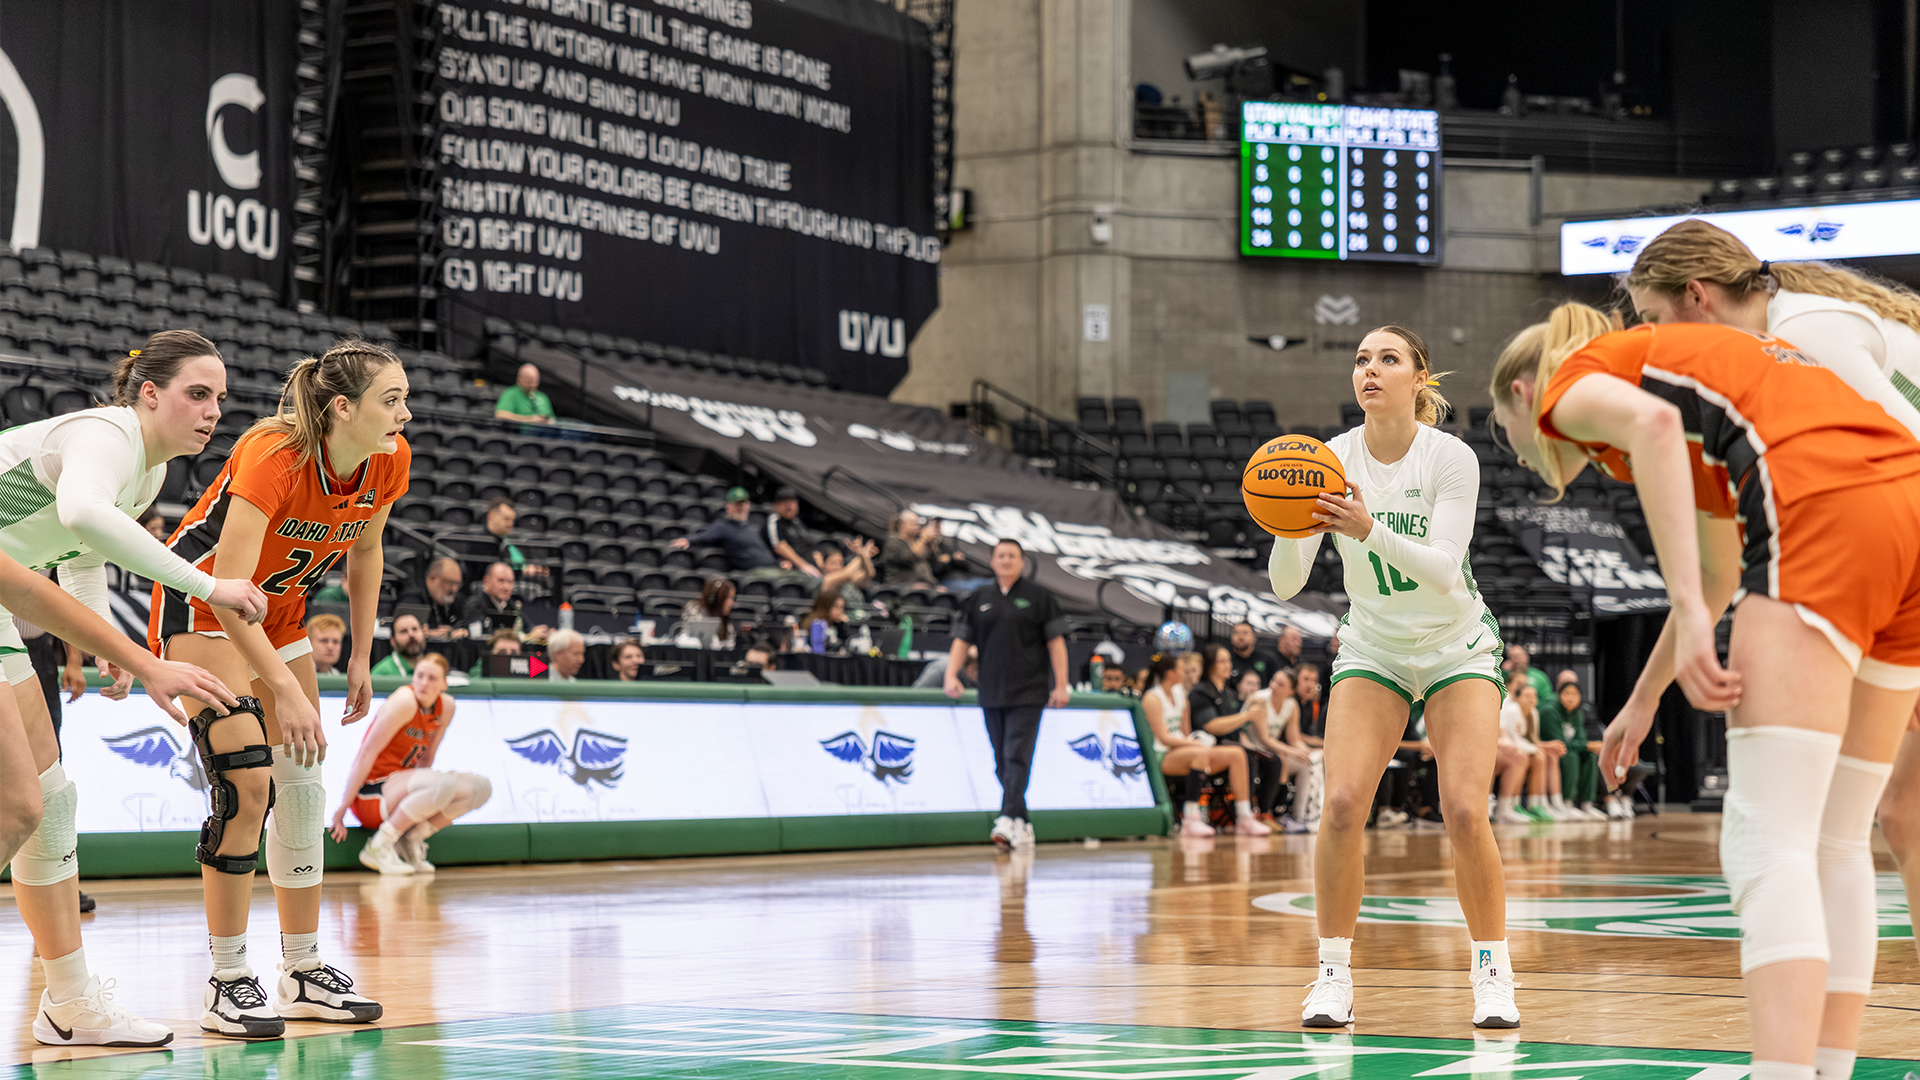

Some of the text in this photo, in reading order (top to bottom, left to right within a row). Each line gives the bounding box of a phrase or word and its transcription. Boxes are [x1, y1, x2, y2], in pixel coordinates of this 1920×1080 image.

[626, 6, 669, 46] TILL
[669, 18, 708, 56] THE
[708, 30, 761, 72] GAME
[762, 45, 781, 76] IS
[781, 49, 831, 91] DONE
[438, 3, 487, 41] TILL
[485, 10, 529, 48] THE
[529, 20, 616, 70] VICTORY
[616, 43, 650, 79] WE
[650, 52, 702, 93] HAVE
[803, 94, 851, 134] WON!
[438, 47, 680, 127] STAND UP AND SING UVU
[440, 90, 791, 191] OUR SONG WILL RING LOUD AND TRUE
[1289, 145, 1302, 161] 0
[1322, 147, 1334, 163] 0
[1351, 148, 1429, 168] 1 4 0
[1322, 168, 1334, 185] 1
[1352, 169, 1428, 189] 2 2 1
[441, 133, 941, 264] FOLLOW YOUR COLORS BE GREEN THROUGH AND THROUG
[1252, 186, 1334, 206] 10 1 0
[1384, 192, 1397, 210] 2
[1416, 194, 1428, 211] 1
[442, 177, 720, 255] MIGHTY WOLVERINES OF UVU
[1289, 210, 1302, 226] 0
[1322, 211, 1334, 228] 0
[1416, 215, 1428, 232] 1
[443, 216, 476, 249] GO
[537, 224, 583, 261] UVU
[1289, 231, 1302, 248] 0
[1322, 232, 1334, 249] 0
[1348, 234, 1429, 253] 24 0 0
[443, 258, 478, 292] GO
[537, 265, 583, 302] UVU
[838, 309, 906, 358] UVU
[1266, 441, 1319, 455] NCAA
[1257, 468, 1326, 488] Wilson
[1403, 488, 1422, 499] WA
[275, 517, 372, 544] IDAHO STATE
[1370, 511, 1430, 539] ERINES
[258, 547, 343, 597] 24
